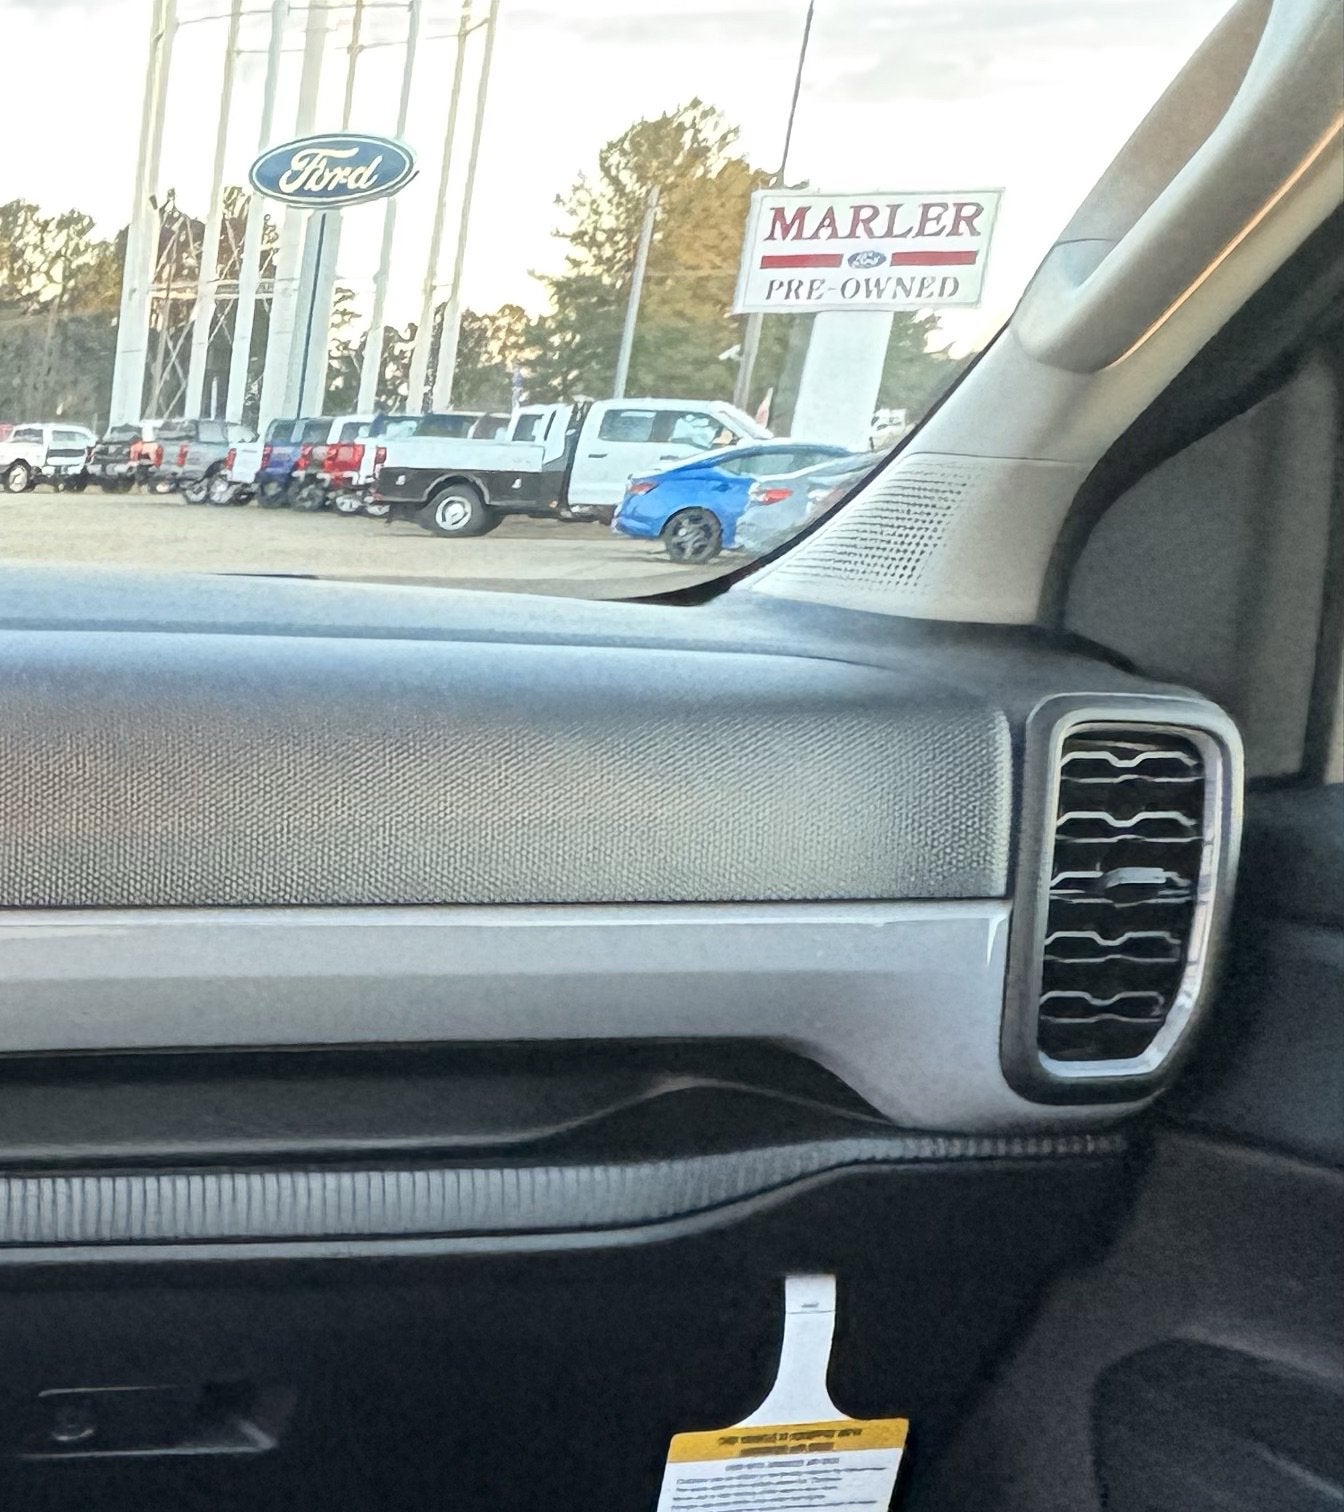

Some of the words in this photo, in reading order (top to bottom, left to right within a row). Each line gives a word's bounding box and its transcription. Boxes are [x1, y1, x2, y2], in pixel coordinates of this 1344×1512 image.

[278, 146, 384, 194] Ford
[763, 202, 985, 242] MARLER
[765, 276, 960, 301] PRE-OWNED
